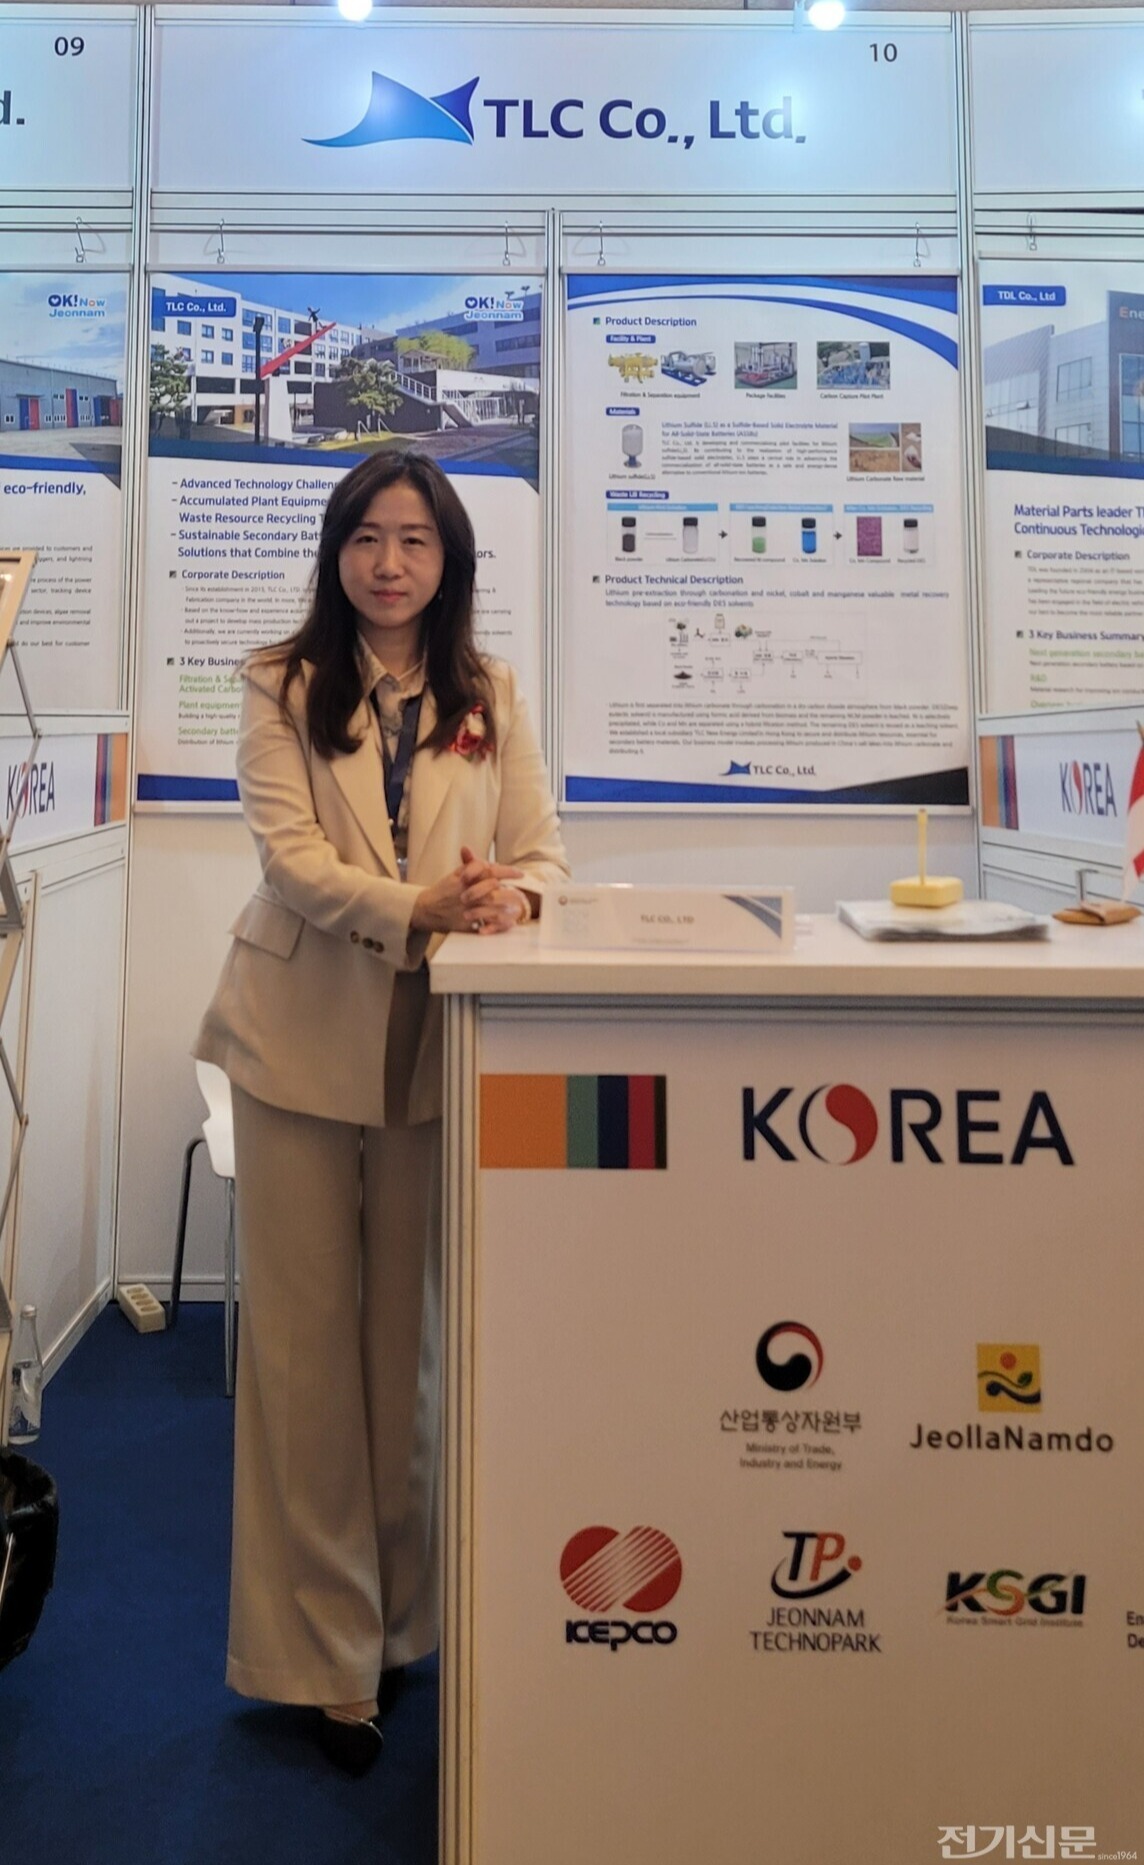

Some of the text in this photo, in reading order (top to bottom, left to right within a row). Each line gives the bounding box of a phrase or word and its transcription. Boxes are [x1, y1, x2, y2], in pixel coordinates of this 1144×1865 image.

[54, 36, 84, 56] 09
[869, 43, 897, 62] 10
[483, 96, 807, 149] TLC Co., Ltd.
[48, 294, 105, 308] OK! Now
[998, 291, 1016, 300] TDL
[1040, 292, 1056, 300] Ltd
[166, 302, 226, 314] TLC Co., Ltd.
[464, 297, 522, 310] OK! Now
[49, 309, 105, 318] Jeonnam
[466, 310, 522, 320] Jeonnam
[606, 317, 697, 326] Product Description
[4, 482, 86, 496] eco-friendly,
[180, 479, 337, 490] Advanced Technology Challen
[180, 496, 328, 507] Accumulated Plant Equipme
[1014, 504, 1060, 516] Material
[1063, 506, 1094, 518] Parts
[1097, 506, 1132, 518] leader
[179, 513, 212, 523] Waste
[215, 513, 264, 523] Resource
[267, 513, 316, 524] Recycling
[1014, 522, 1077, 536] Continuous
[179, 530, 320, 541] Sustainable Secondary Bat
[178, 547, 227, 558] Solutions
[230, 547, 252, 558] that
[255, 547, 300, 558] Combine
[476, 550, 496, 558] ors.
[1027, 550, 1130, 560] Corporate Description
[182, 570, 284, 580] Corporate Description
[606, 576, 744, 584] Product Technical Description
[1029, 630, 1034, 638] 3
[1037, 630, 1053, 640] Key
[1056, 631, 1098, 640] Business
[180, 657, 240, 666] 3 Key Busine
[180, 675, 212, 683] Filtration
[216, 675, 221, 683] &
[179, 701, 240, 709] Plant equipmen
[178, 728, 238, 736] Secondary batt
[753, 766, 773, 774] TLC
[797, 766, 816, 775] Ltd.
[1060, 760, 1117, 818] KOREA
[742, 1083, 1075, 1165] KOREA
[720, 1409, 862, 1433] 산업통상자원부
[910, 1424, 1114, 1452] JeollaNamdo
[746, 1443, 834, 1455] Ministry of Trade,
[740, 1458, 842, 1471] Industry and Energy
[946, 1569, 1086, 1616] KSGI
[767, 1607, 864, 1628] JEONNAM
[947, 1616, 1083, 1627] Korea Smart Grid Institute
[566, 1620, 678, 1652] KEPCO
[750, 1631, 882, 1652] TECHNOPARK
